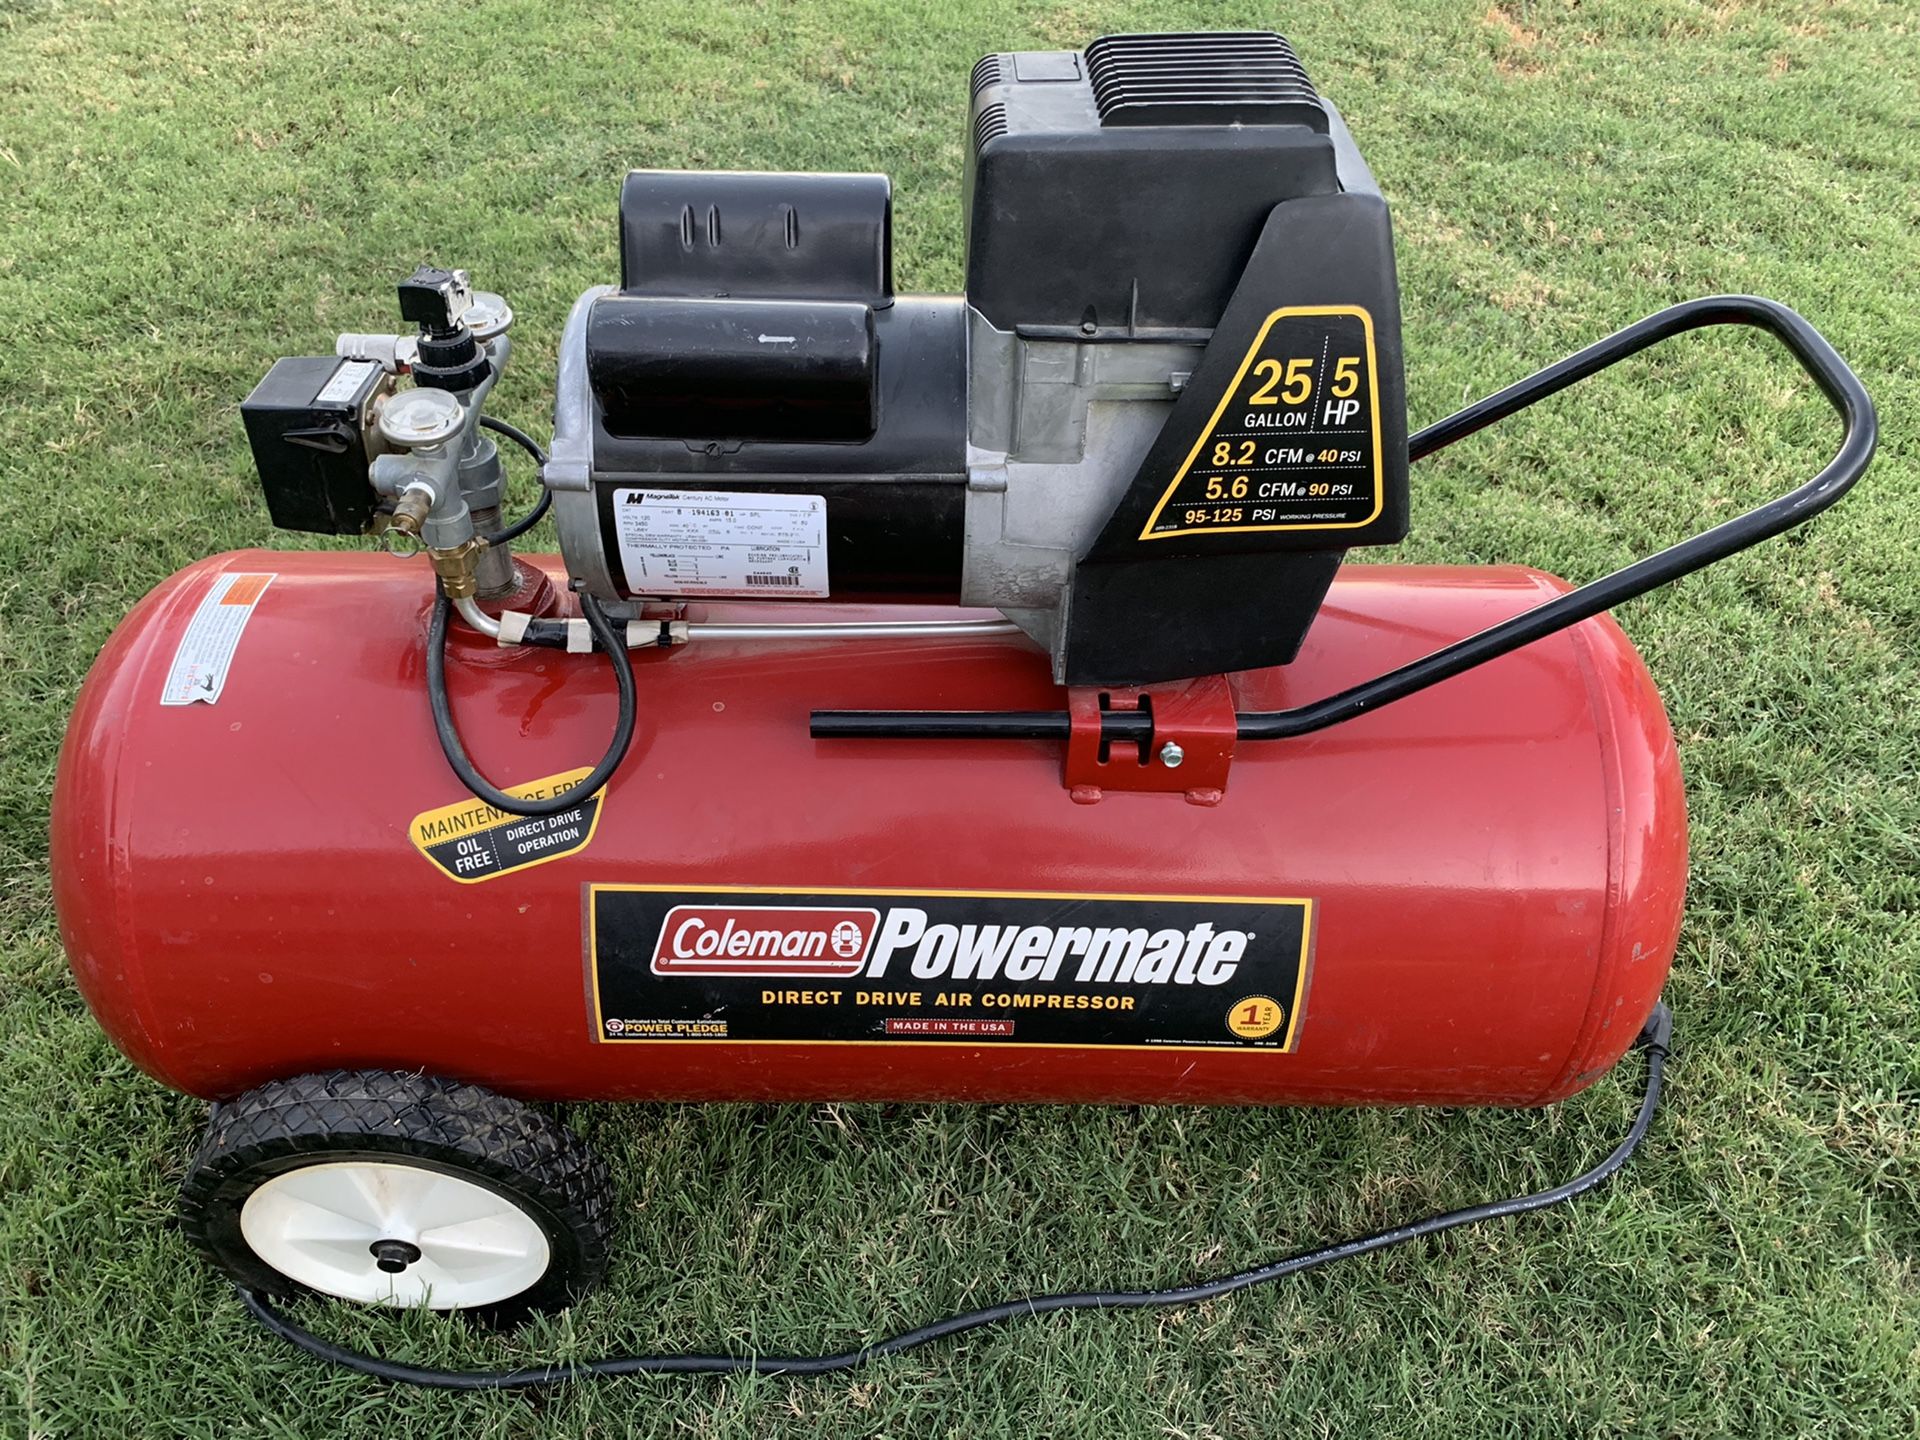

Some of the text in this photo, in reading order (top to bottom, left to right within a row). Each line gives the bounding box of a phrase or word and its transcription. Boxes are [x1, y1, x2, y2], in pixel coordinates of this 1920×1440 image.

[1249, 358, 1315, 405] 25
[1331, 357, 1360, 398] 5
[1244, 412, 1307, 428] GALLON
[1322, 400, 1360, 425] HP
[1212, 441, 1256, 467] 8.2
[1264, 448, 1303, 465] CFM
[1317, 449, 1338, 463] 40
[1339, 450, 1361, 463] PSI
[682, 494, 703, 502] Century
[1205, 475, 1249, 500] 5.6
[1258, 482, 1296, 497] CFM
[1308, 483, 1329, 496] 90
[1331, 484, 1353, 496] PSI
[1185, 508, 1243, 524] 95-125
[1252, 509, 1276, 521] PSI
[420, 790, 545, 841] MAINTENACE
[506, 809, 583, 842] DIRECT DRIVE
[456, 838, 483, 855] OIL
[517, 827, 580, 855] OPERATION
[455, 850, 493, 873] FREE
[673, 917, 828, 959] Coleman
[762, 990, 1136, 1010] DIRECT DRIVE AIR COMPRESSOR
[1240, 1005, 1261, 1025] 1
[1262, 1006, 1273, 1025] YEAR
[625, 1024, 728, 1033] POWER PLEDGE
[893, 1022, 1006, 1032] MADE IN THE USA
